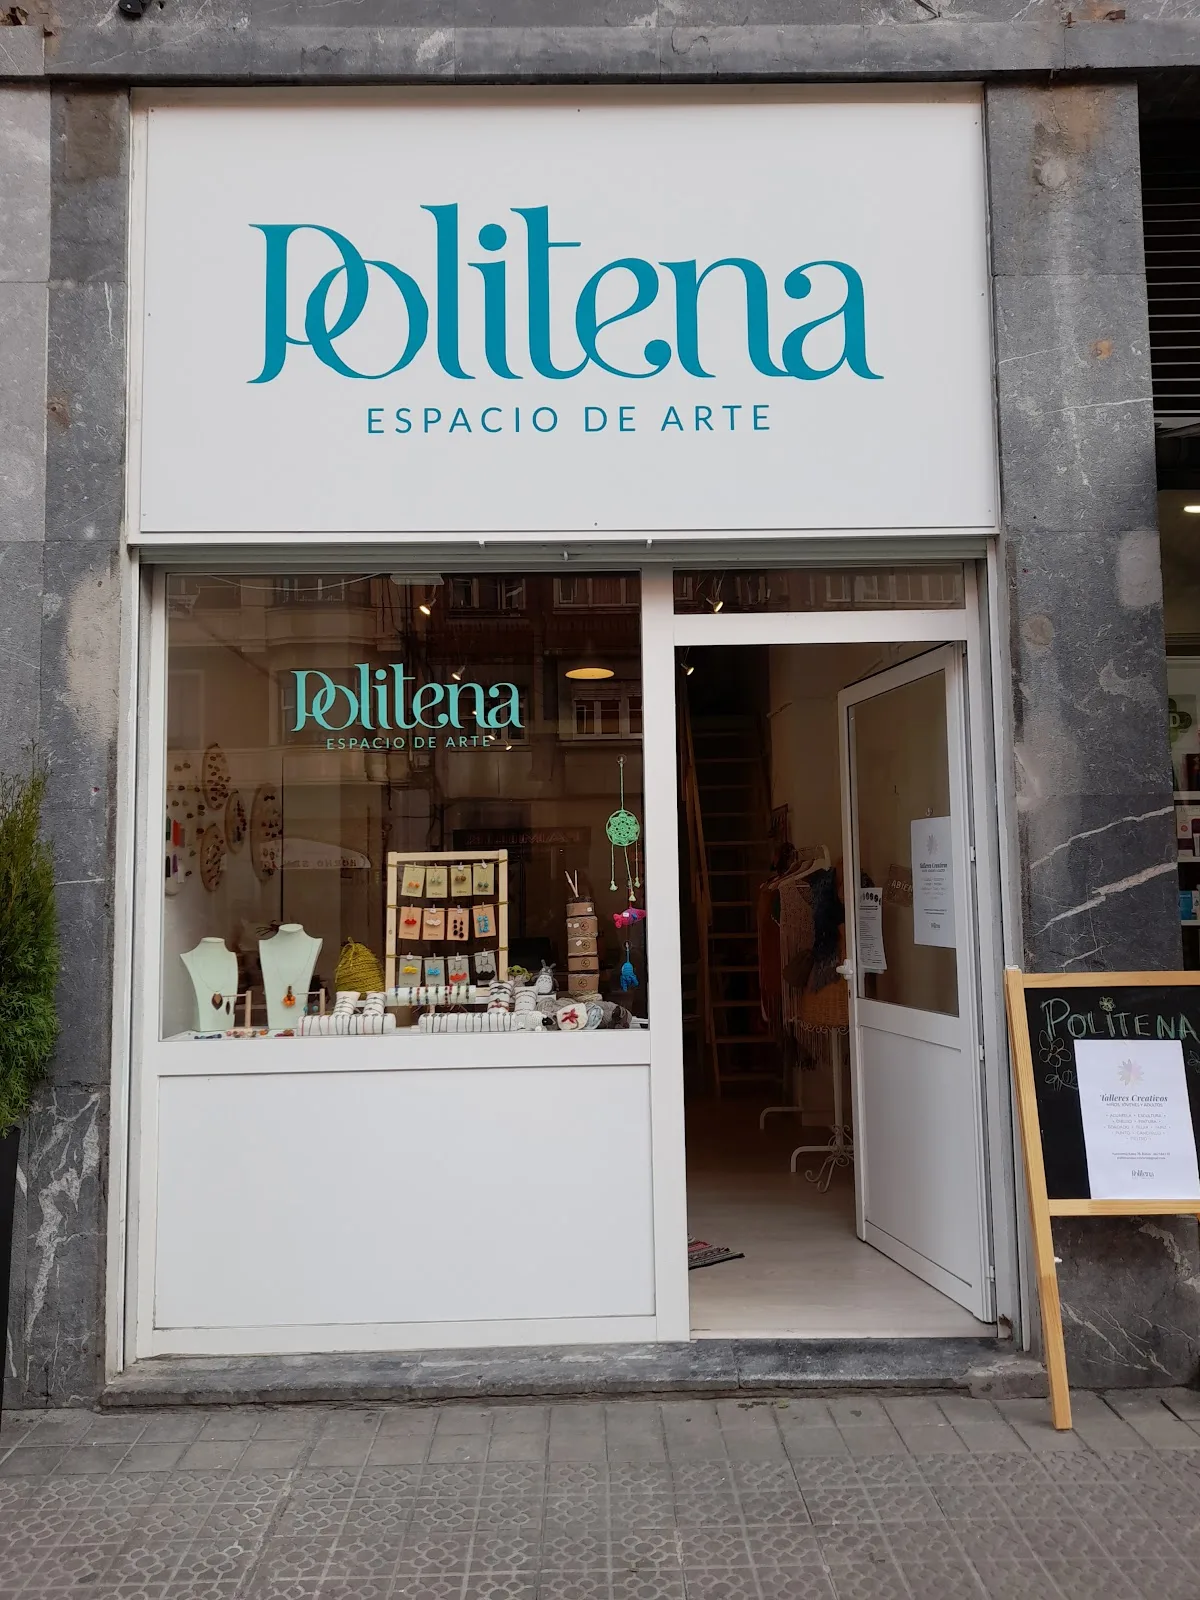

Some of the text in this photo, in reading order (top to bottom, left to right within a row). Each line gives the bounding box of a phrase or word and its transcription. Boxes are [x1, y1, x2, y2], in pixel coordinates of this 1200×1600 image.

[248, 202, 884, 385] Politena
[367, 404, 769, 434] ESPACIO DE ARTE
[290, 662, 525, 732] Politena
[326, 735, 491, 750] ESPACIO DE ARTE
[1040, 997, 1200, 1043] POLITENA
[1100, 1093, 1168, 1102] Talleres Creativos
